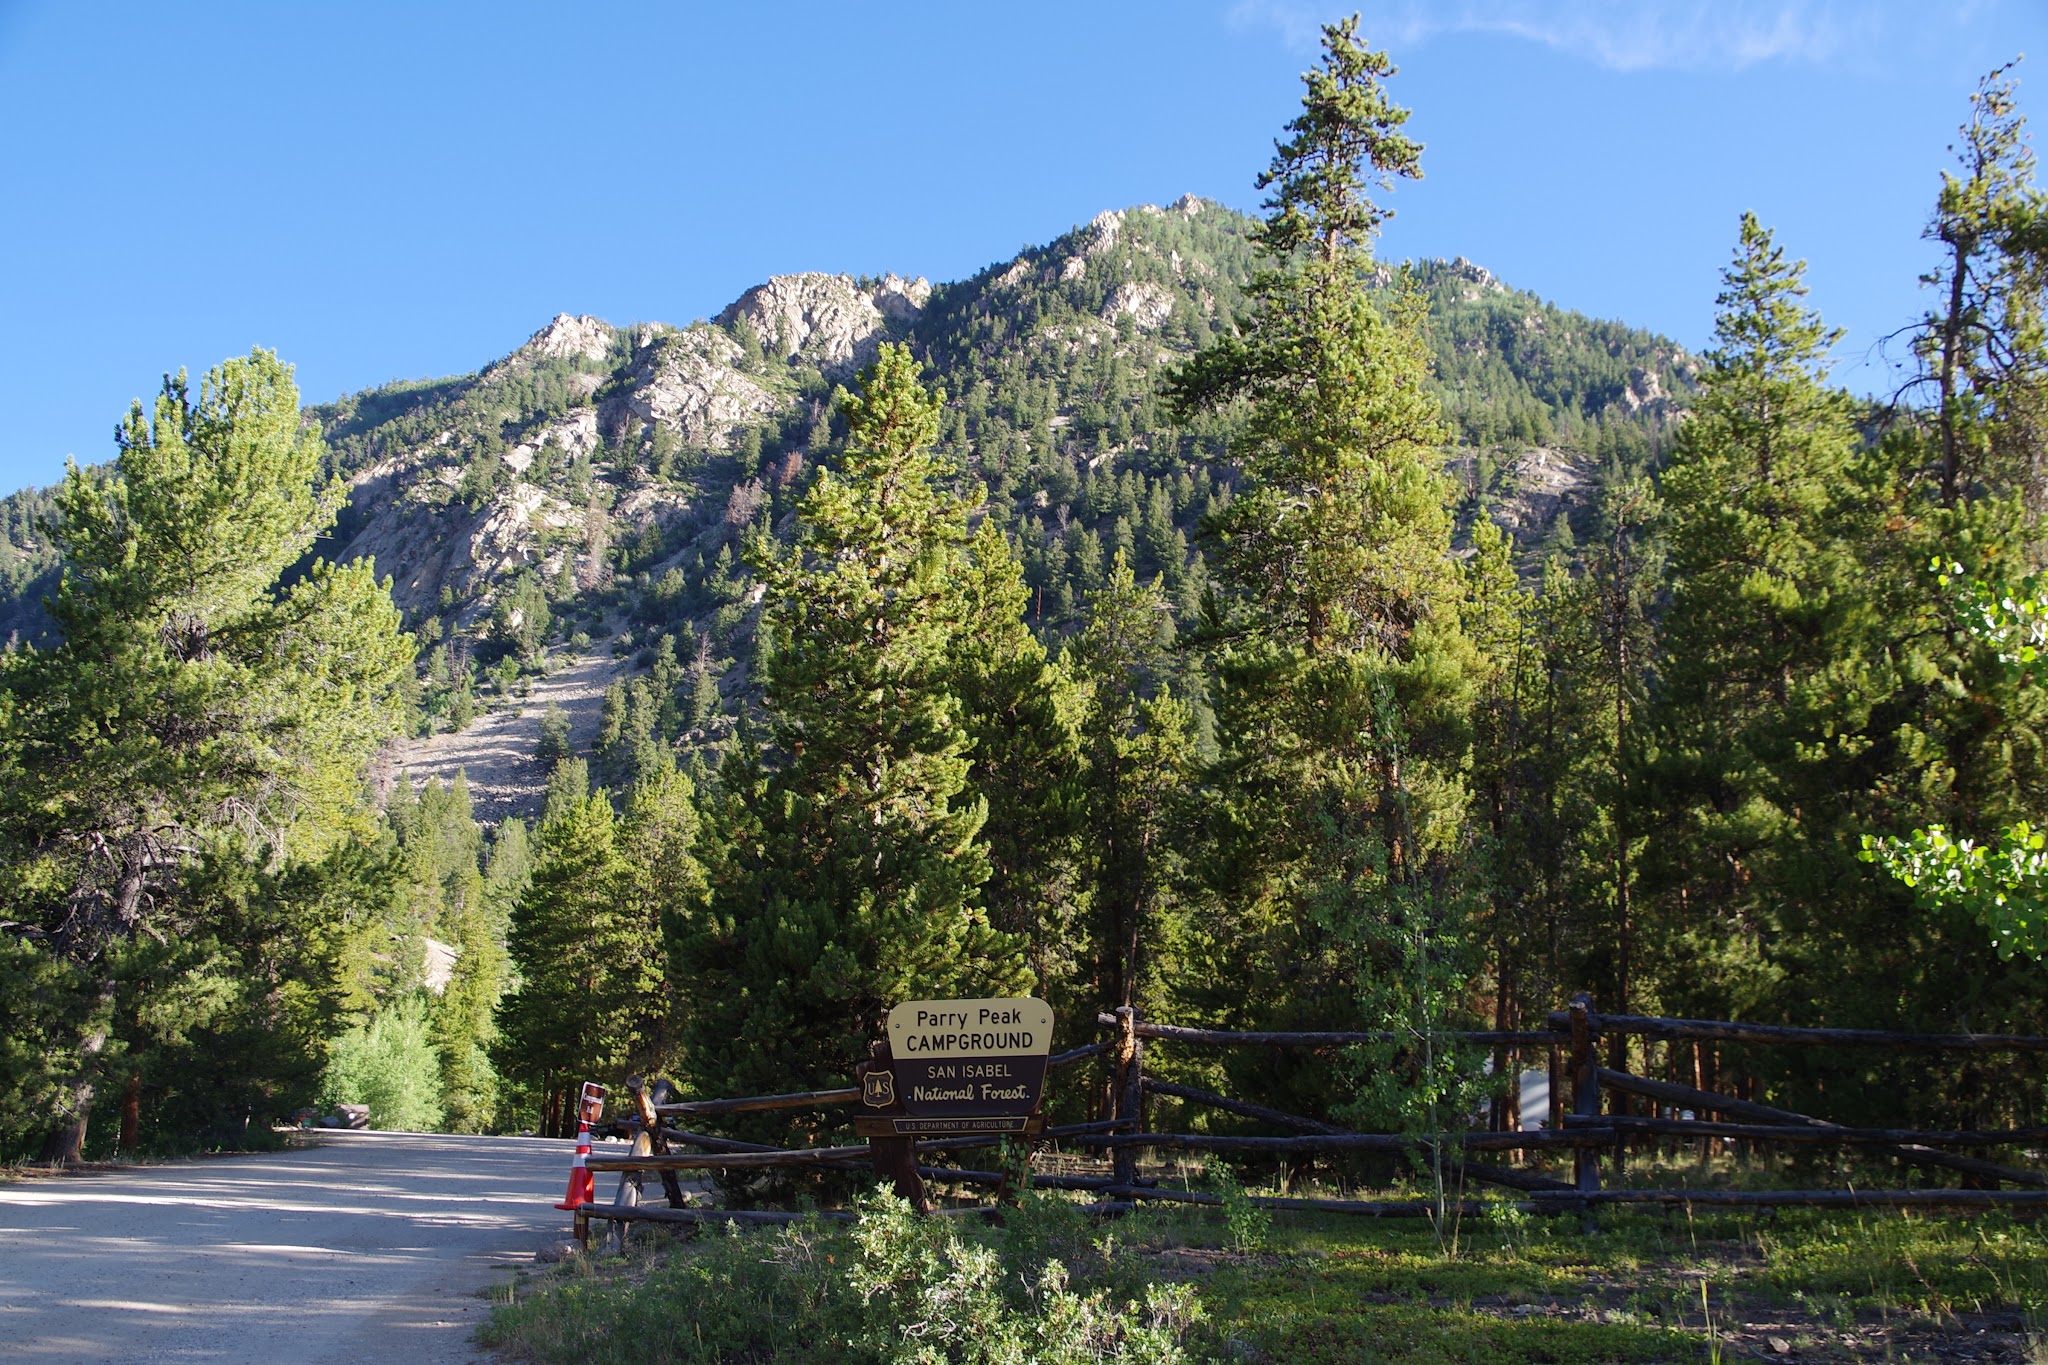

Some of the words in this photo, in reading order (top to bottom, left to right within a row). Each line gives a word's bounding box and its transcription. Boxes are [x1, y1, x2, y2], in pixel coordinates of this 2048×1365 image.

[917, 1010, 968, 1030] Parry
[979, 1008, 1022, 1025] Peak
[906, 1032, 1033, 1052] CAMPGROUND
[927, 1065, 956, 1079] SAN
[962, 1064, 1012, 1078] ISABEL
[913, 1083, 975, 1102] National
[980, 1083, 1026, 1101] Forest
[919, 1121, 959, 1130] DEPARTMENT
[961, 1121, 970, 1129] OF
[972, 1120, 1014, 1129] AGRICULTURE
